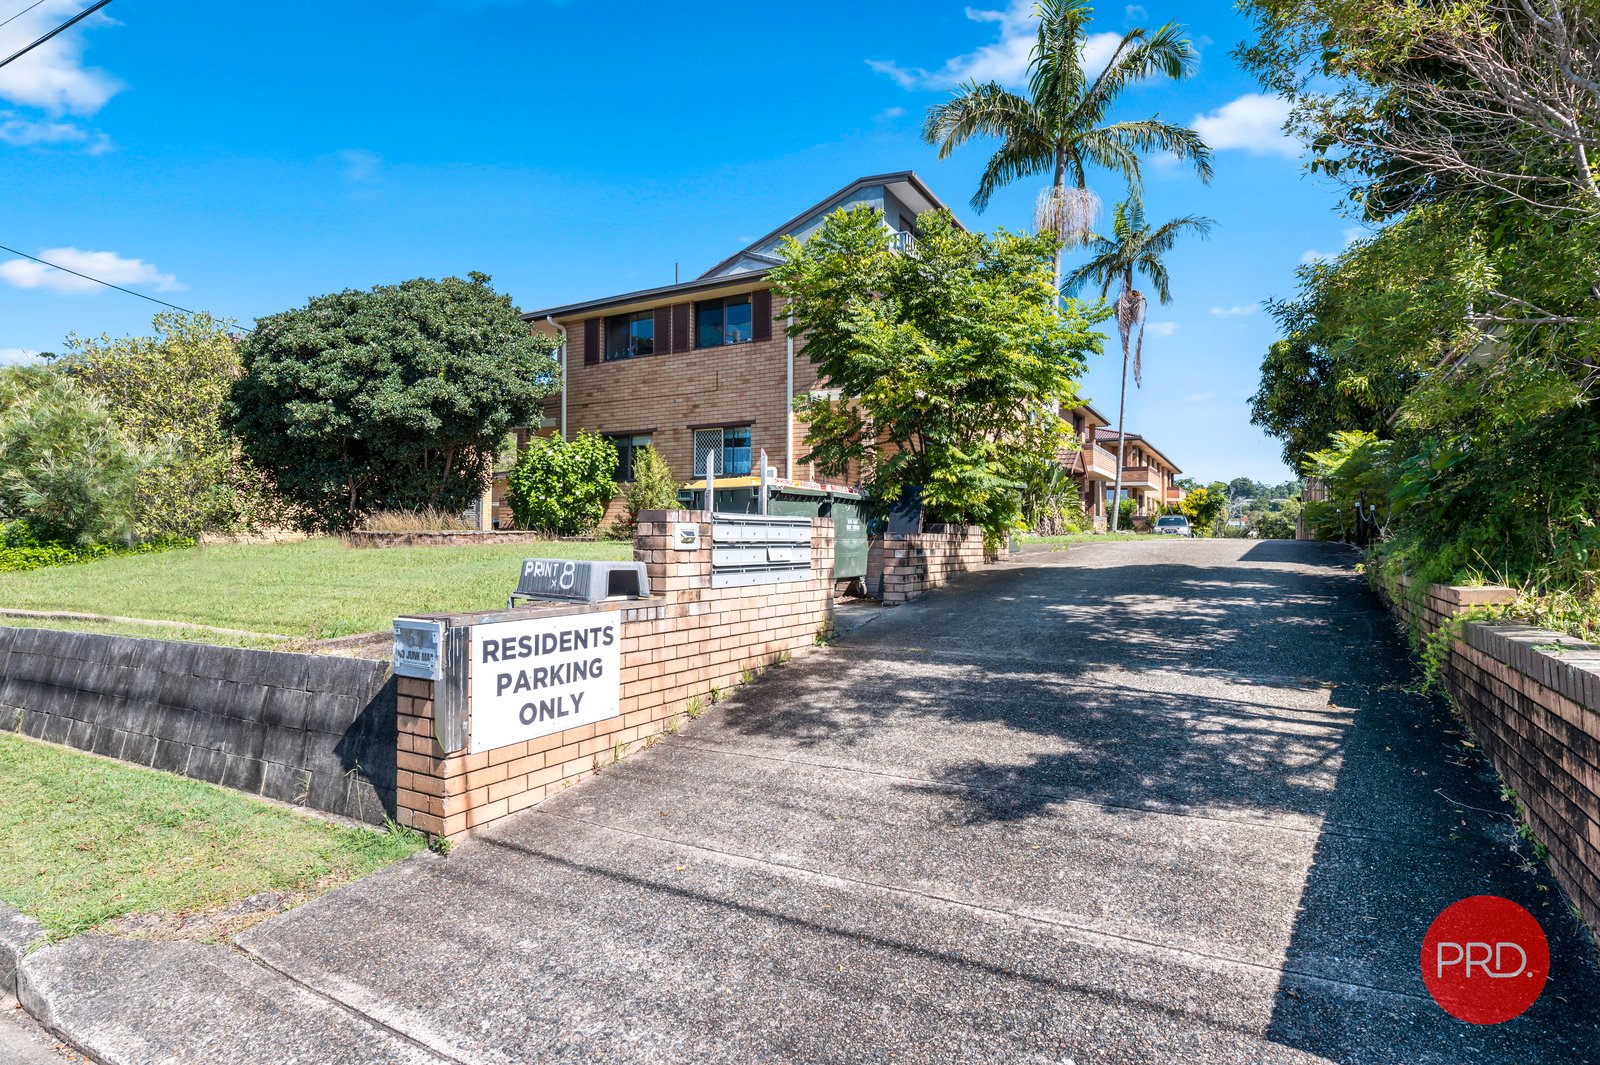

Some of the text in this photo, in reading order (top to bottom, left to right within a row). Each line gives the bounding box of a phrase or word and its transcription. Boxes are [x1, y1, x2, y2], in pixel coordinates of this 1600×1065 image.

[524, 561, 559, 577] PRINT
[559, 561, 575, 589] 8
[406, 650, 420, 660] JUNK
[482, 626, 614, 663] RESIDENTS
[496, 657, 603, 697] PARKING
[518, 692, 585, 726] ONLY
